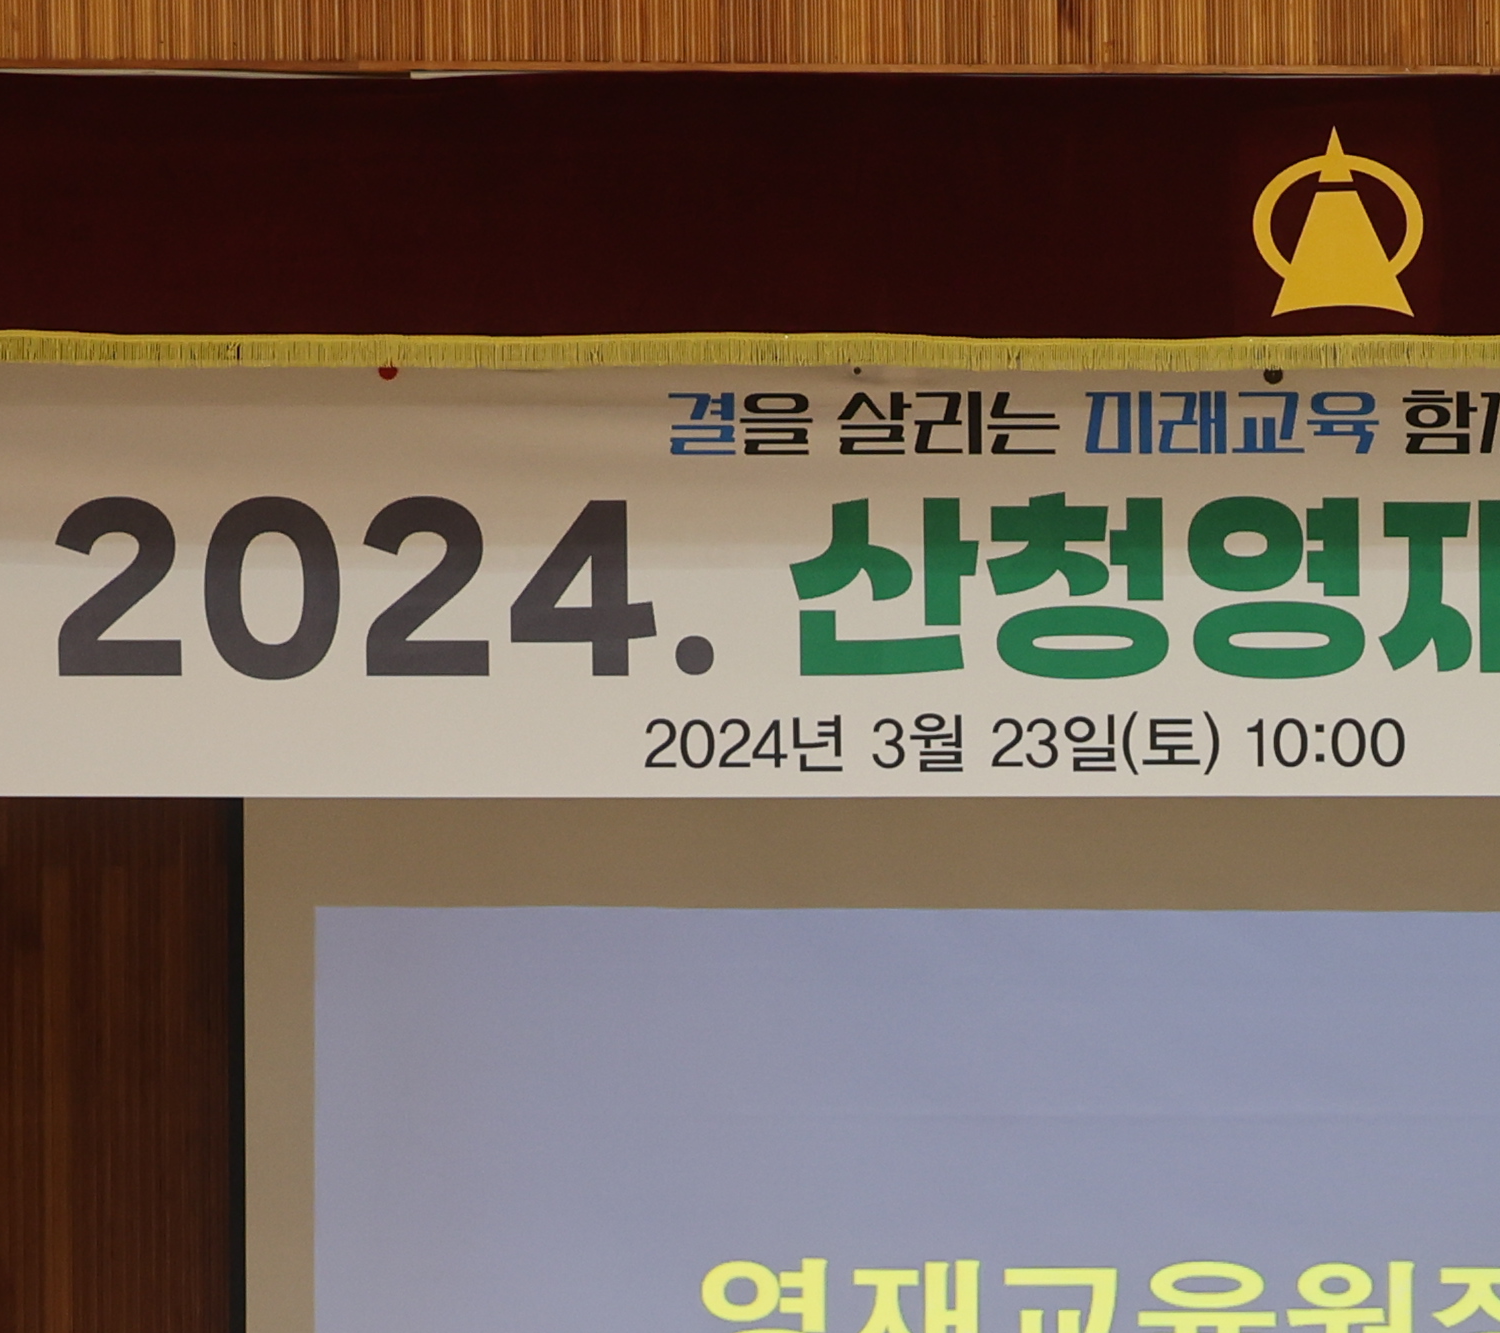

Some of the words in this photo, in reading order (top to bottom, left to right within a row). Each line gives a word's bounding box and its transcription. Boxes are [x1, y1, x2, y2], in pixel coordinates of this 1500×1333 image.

[667, 391, 813, 455] 결을
[837, 391, 1060, 455] 살리는
[1085, 391, 1379, 455] 미래교육
[54, 495, 714, 681] 2024.
[644, 714, 844, 773] 2024년
[872, 712, 964, 773] 3월
[990, 711, 1220, 776] 23일(토)
[1246, 717, 1406, 768] 10:00
